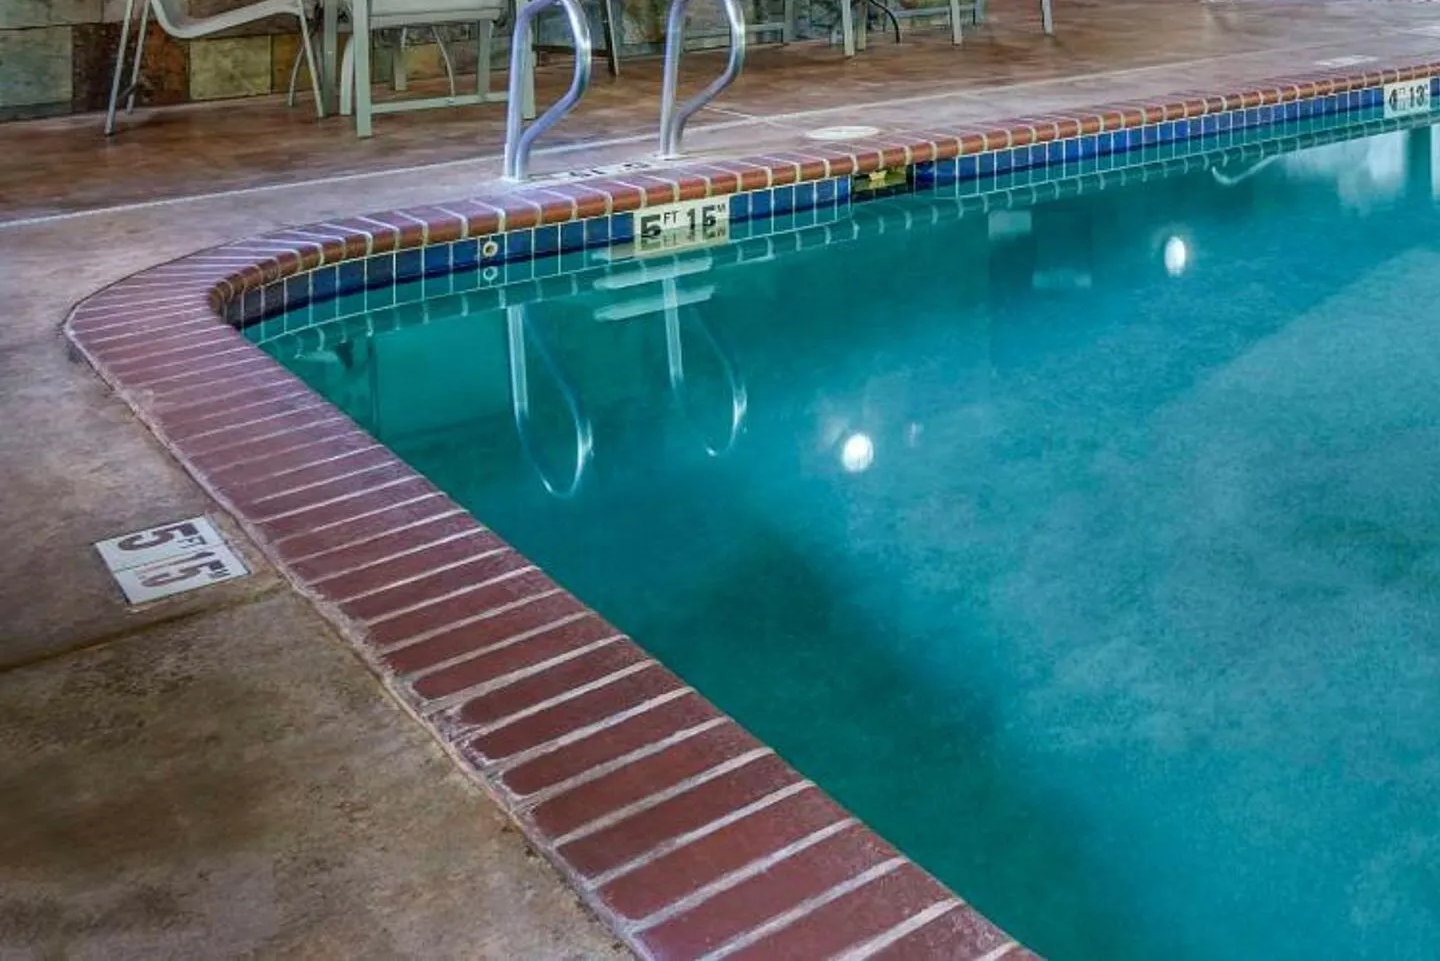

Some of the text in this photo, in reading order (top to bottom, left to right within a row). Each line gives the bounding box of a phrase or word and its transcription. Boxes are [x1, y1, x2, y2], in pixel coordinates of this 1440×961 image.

[640, 214, 661, 238] 5
[664, 210, 679, 224] FT
[118, 522, 199, 551] 5
